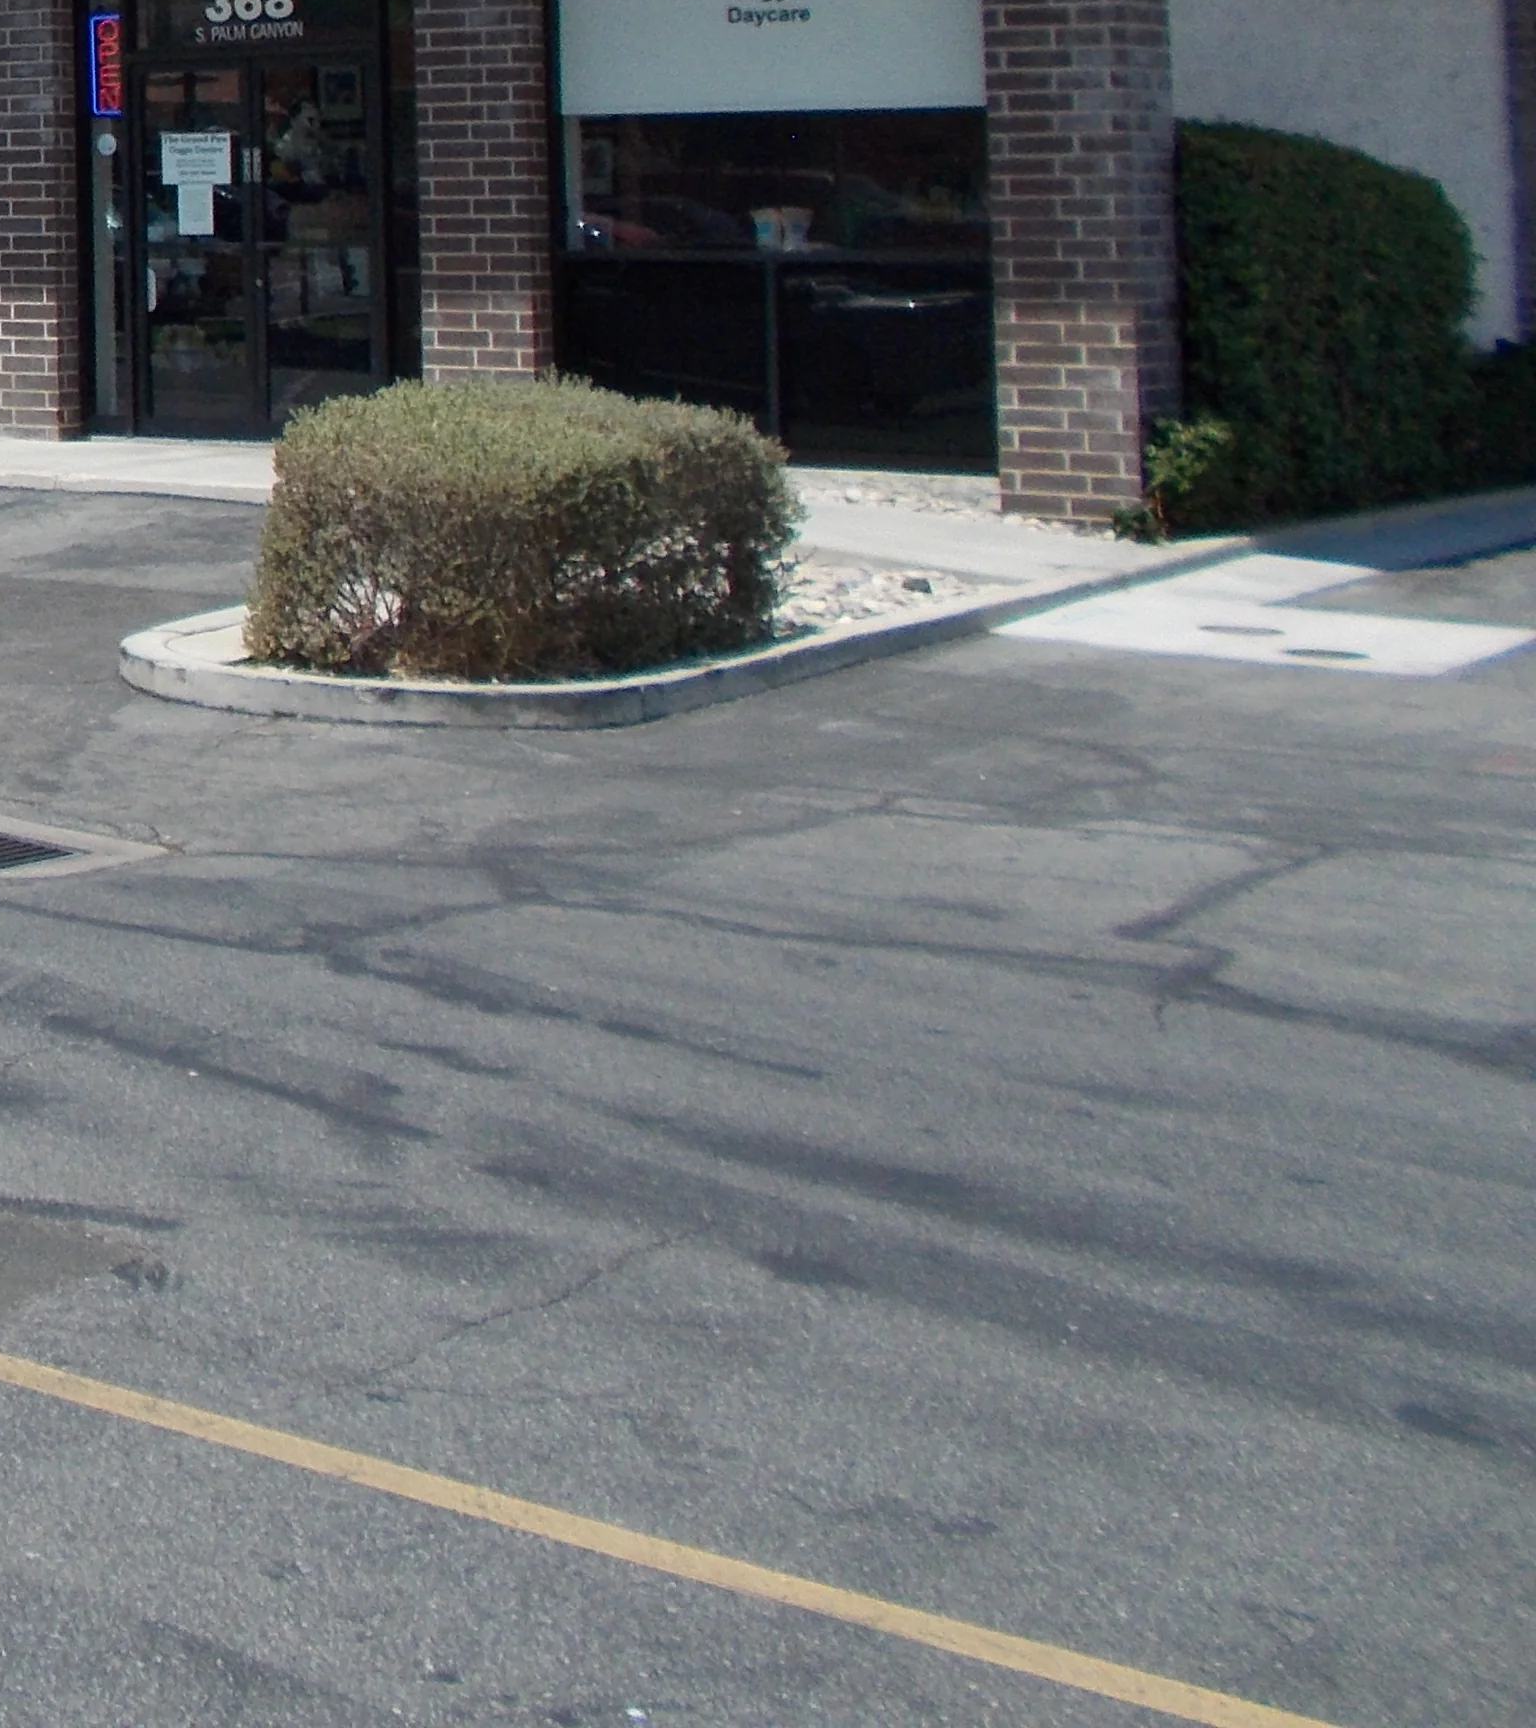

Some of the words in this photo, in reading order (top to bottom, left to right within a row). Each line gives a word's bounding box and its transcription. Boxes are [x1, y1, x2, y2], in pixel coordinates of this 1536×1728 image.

[727, 7, 811, 28] Daycare
[211, 24, 246, 41] PALM
[250, 20, 305, 40] CANYON
[98, 19, 122, 112] OPEN
